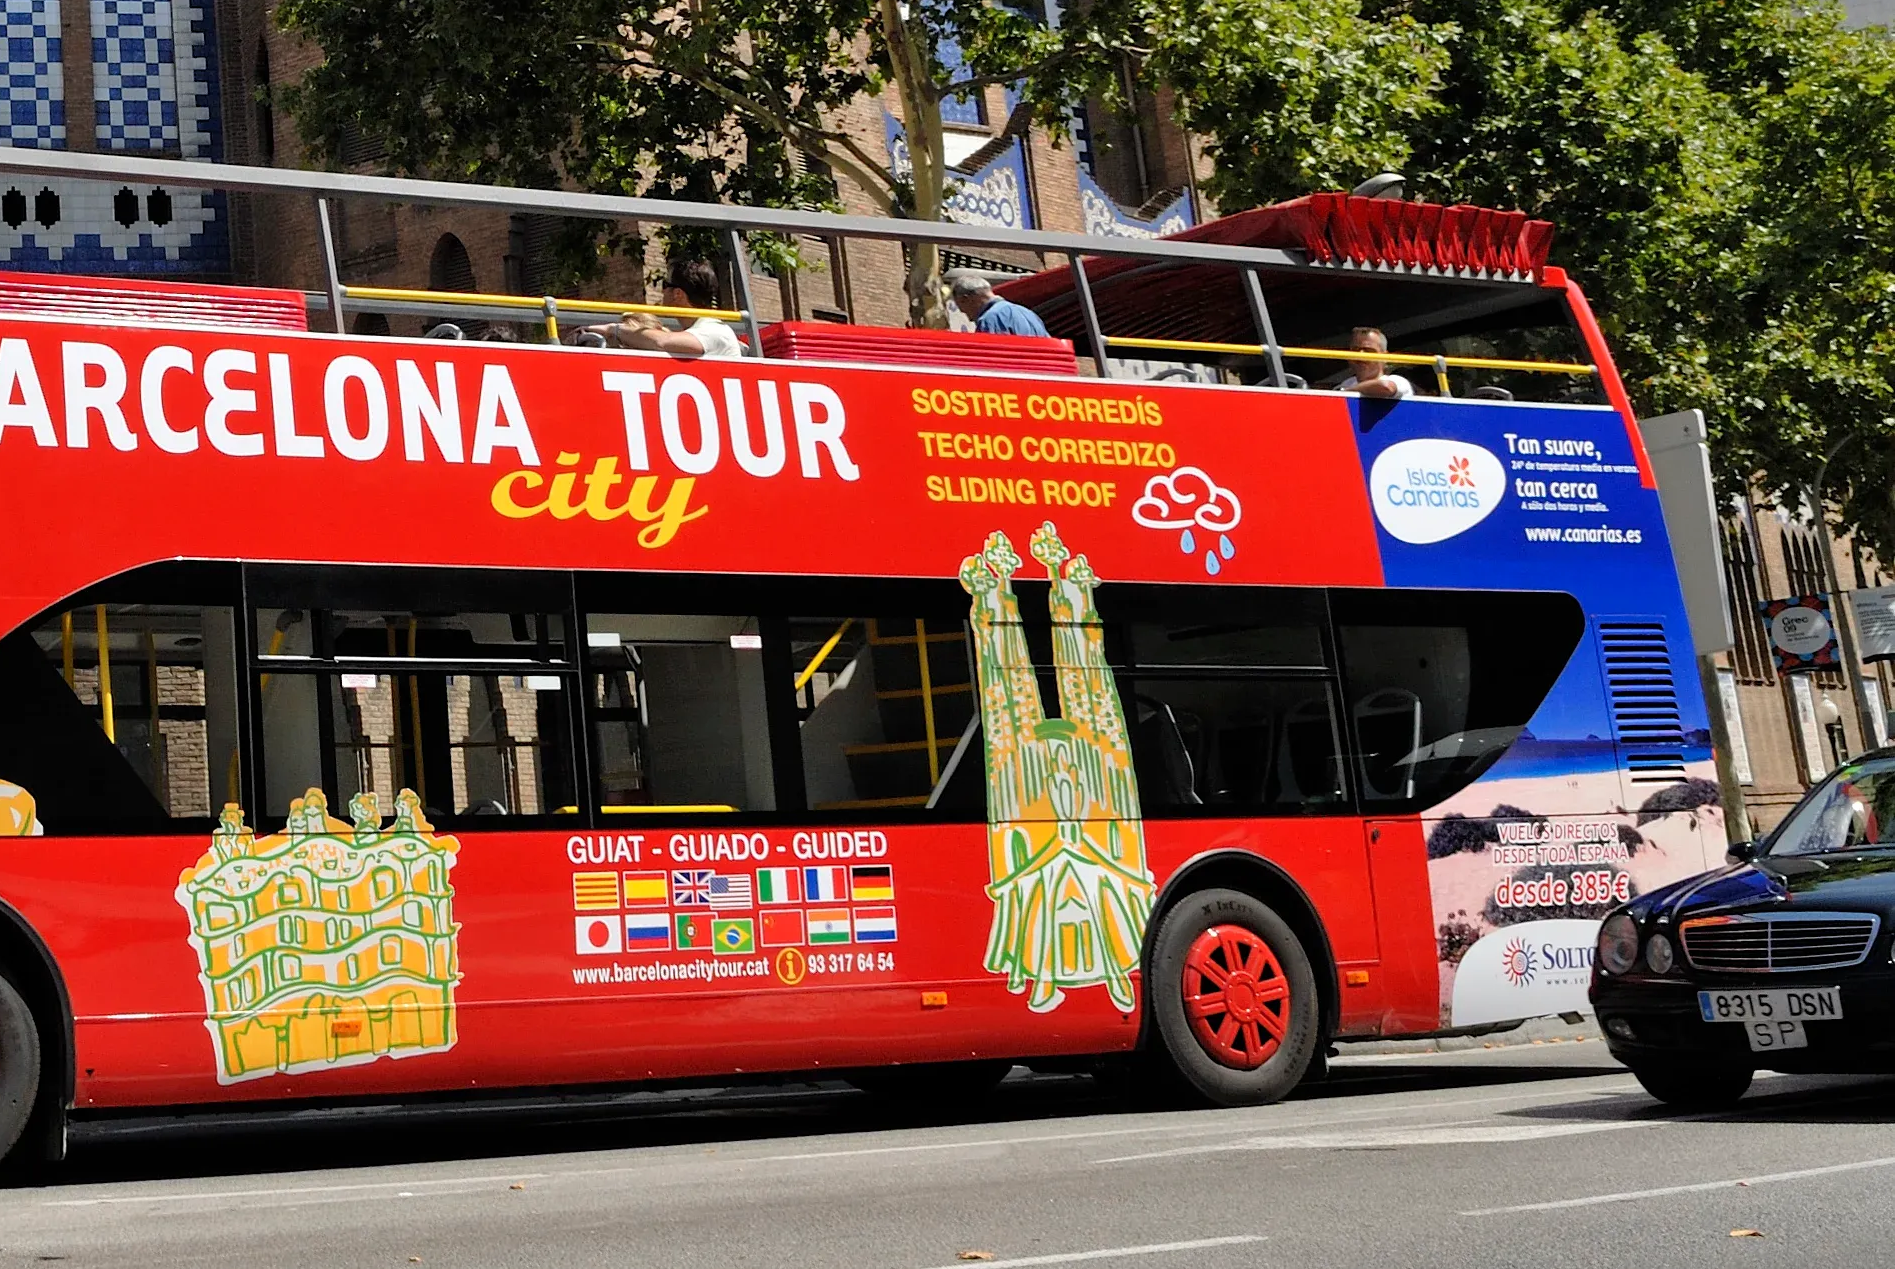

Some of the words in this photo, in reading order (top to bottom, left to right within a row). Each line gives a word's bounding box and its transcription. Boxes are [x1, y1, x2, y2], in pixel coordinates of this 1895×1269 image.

[911, 388, 1022, 420] SOSTRE
[1026, 394, 1164, 427] CORREDÍS
[601, 369, 861, 483] TOUR
[917, 431, 1015, 461] TECHO
[1020, 436, 1178, 469] CORREDIZO
[1503, 433, 1541, 455] Tan
[1543, 439, 1602, 461] suave,
[1406, 467, 1448, 487] Islas
[1515, 477, 1547, 498] tan
[1549, 481, 1599, 500] cerca
[487, 450, 710, 550] city
[926, 475, 1037, 505] SLIDING
[1042, 480, 1118, 508] ROOF
[1387, 484, 1480, 508] Canarias
[1524, 524, 1642, 544] www.canarias.es
[1498, 823, 1551, 842] VUELOS
[1554, 822, 1618, 841] DIRECTOS
[566, 835, 645, 864] GUIAT
[669, 833, 770, 862] GUIADO
[792, 831, 889, 860] GUIDED
[1493, 846, 1535, 865] DESDE
[1538, 844, 1577, 864] TODA
[1496, 876, 1566, 906] desde
[572, 957, 770, 984] www.barcelonacitytour.cat
[807, 954, 826, 974] 93
[828, 953, 854, 973] 317
[857, 952, 874, 972] 64
[877, 951, 895, 972] 54
[1541, 943, 1595, 970] SOLTO
[1716, 994, 1774, 1018] 8315
[1786, 992, 1836, 1017] DSN
